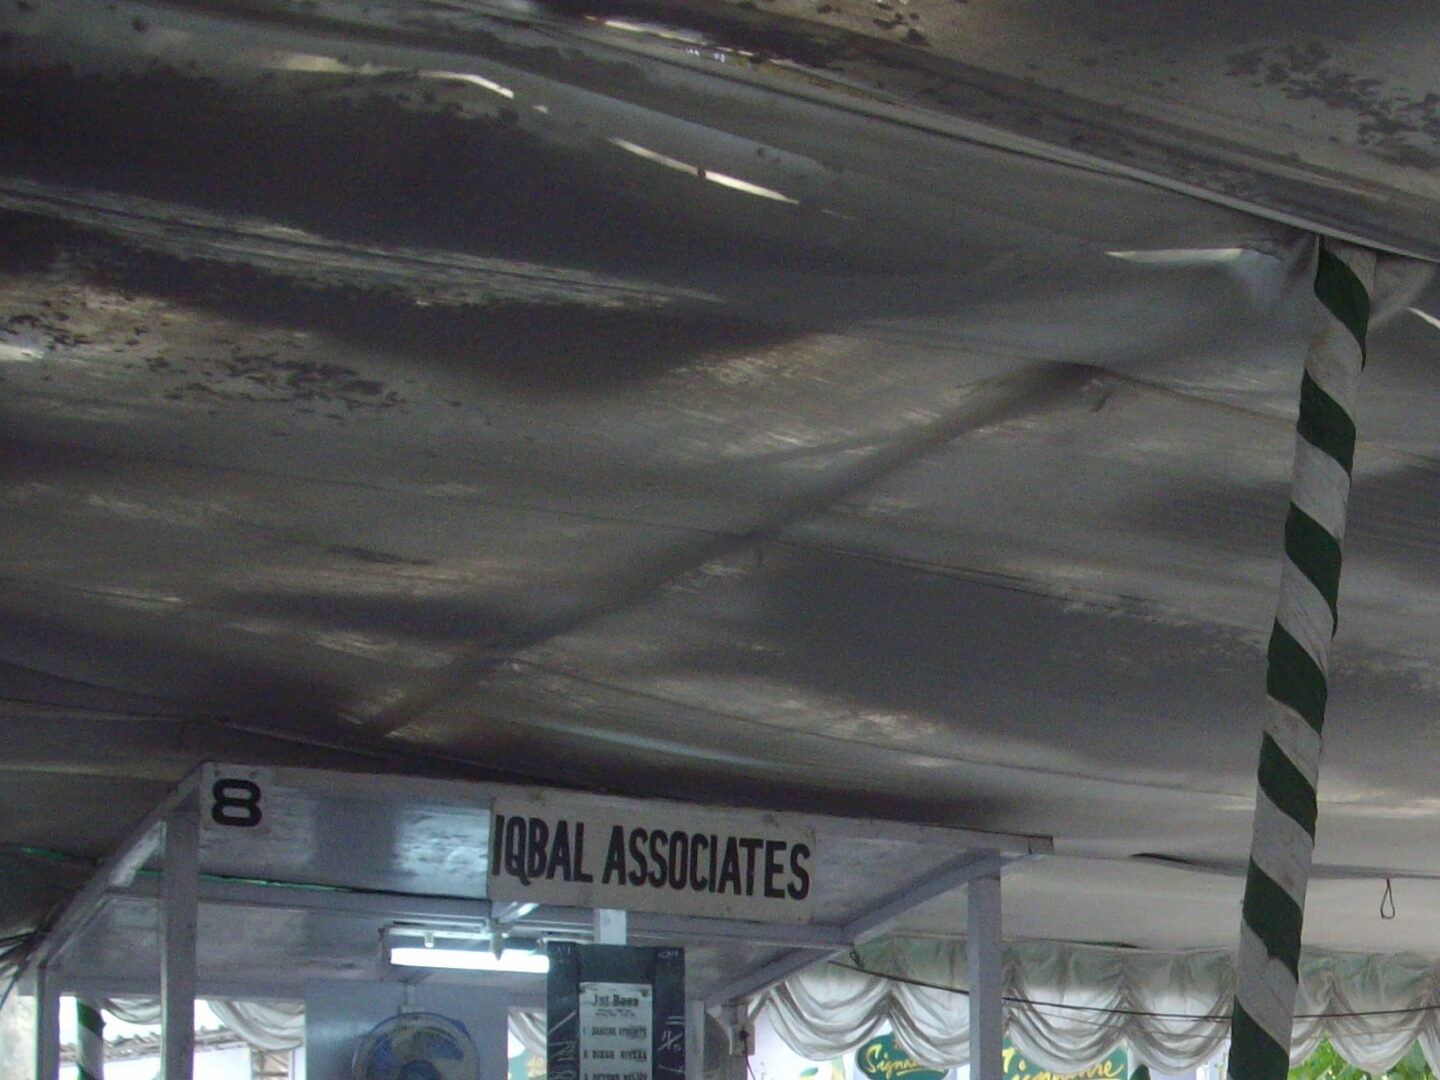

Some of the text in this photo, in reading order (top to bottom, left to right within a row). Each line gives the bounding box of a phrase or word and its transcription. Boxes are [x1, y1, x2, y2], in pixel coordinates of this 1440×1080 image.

[211, 778, 262, 828] 8
[491, 814, 811, 900] IQBAL ASSOCIATES
